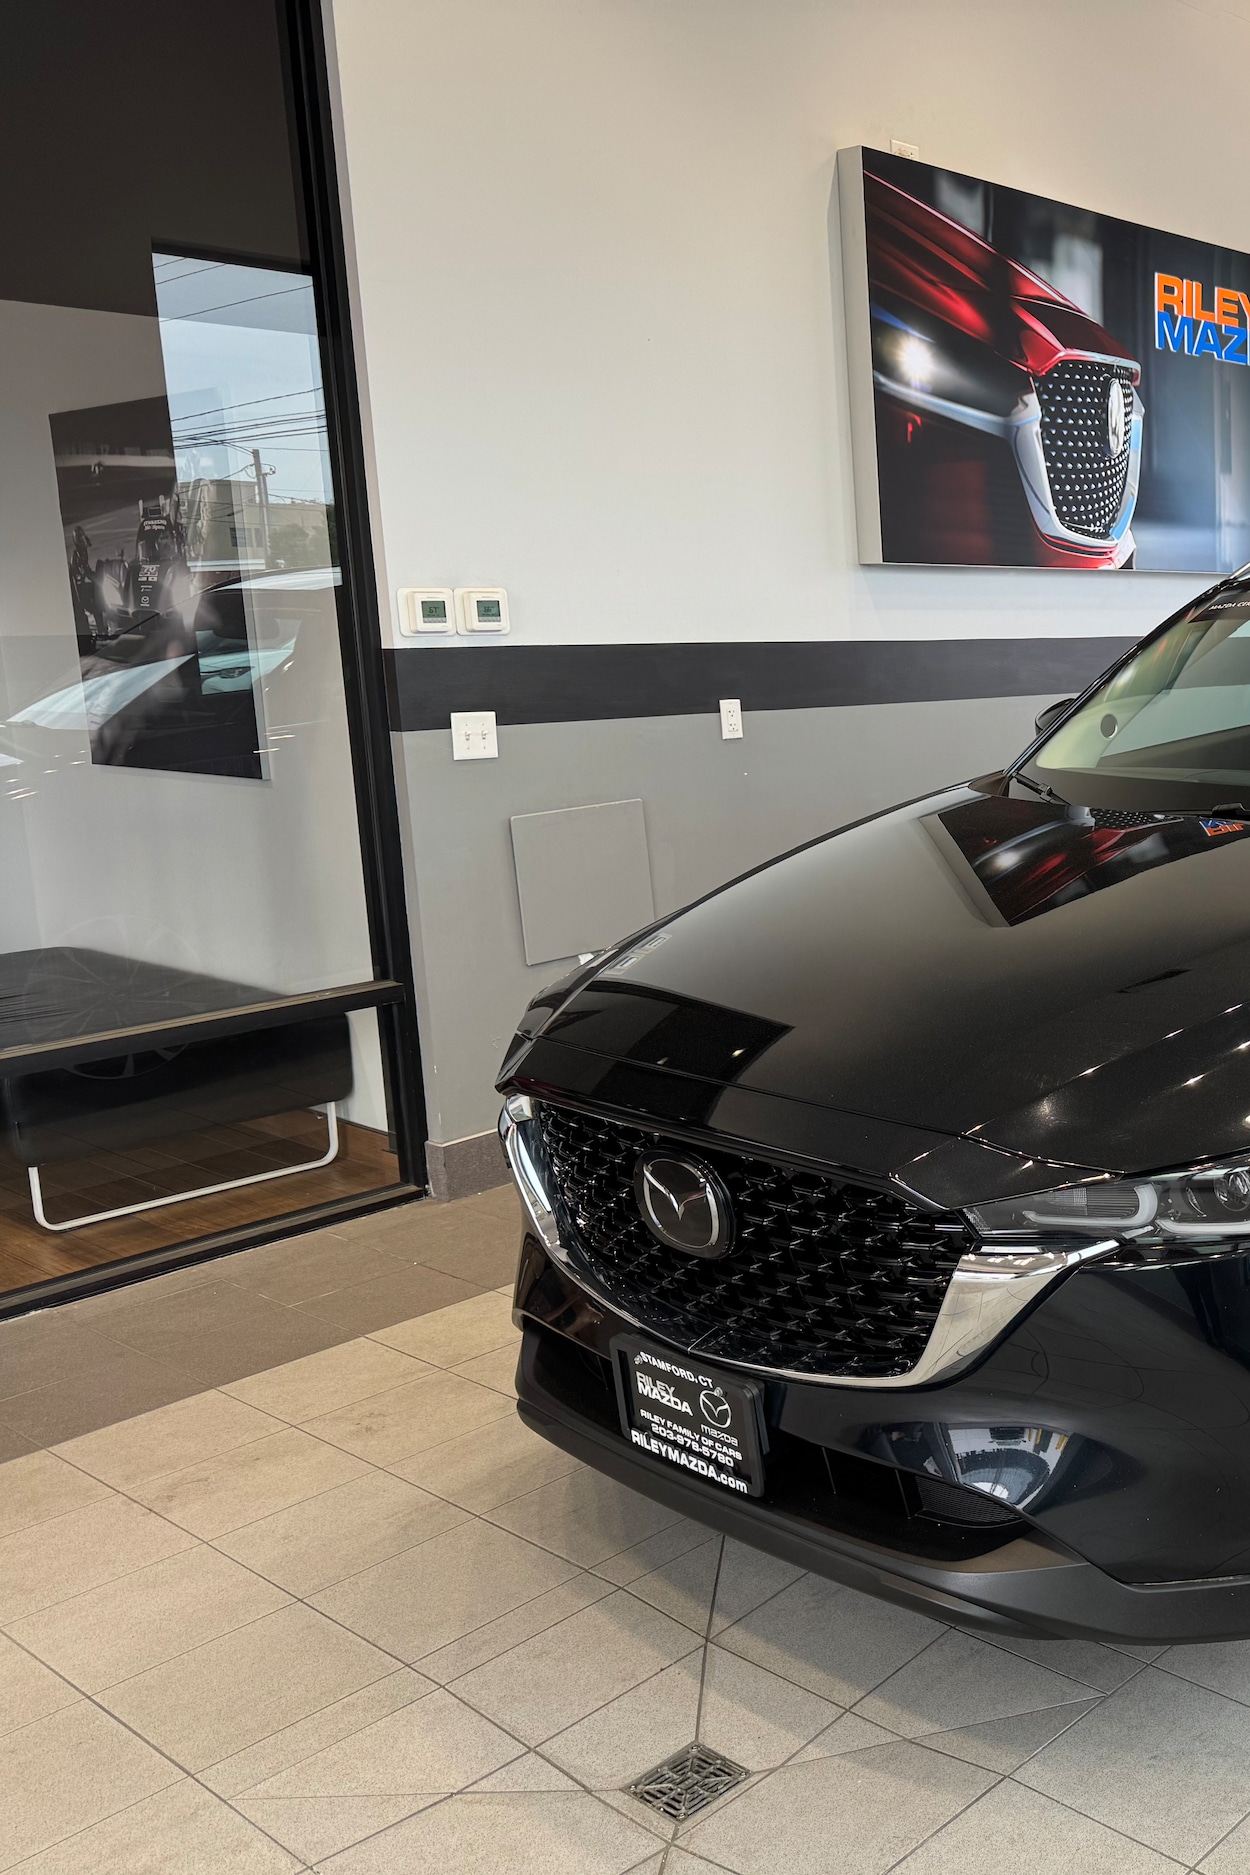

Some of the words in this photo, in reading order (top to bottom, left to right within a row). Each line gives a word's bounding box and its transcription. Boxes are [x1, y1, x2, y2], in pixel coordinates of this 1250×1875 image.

[636, 1371, 675, 1396] RILEY
[637, 1381, 694, 1416] MAZDA
[698, 1375, 713, 1389] CT
[640, 1408, 666, 1426] RILEY
[667, 1420, 700, 1441] FAMILY
[701, 1436, 714, 1450] OF
[715, 1443, 743, 1461] CARS
[631, 1429, 748, 1494] RILEYMAZDA.com
